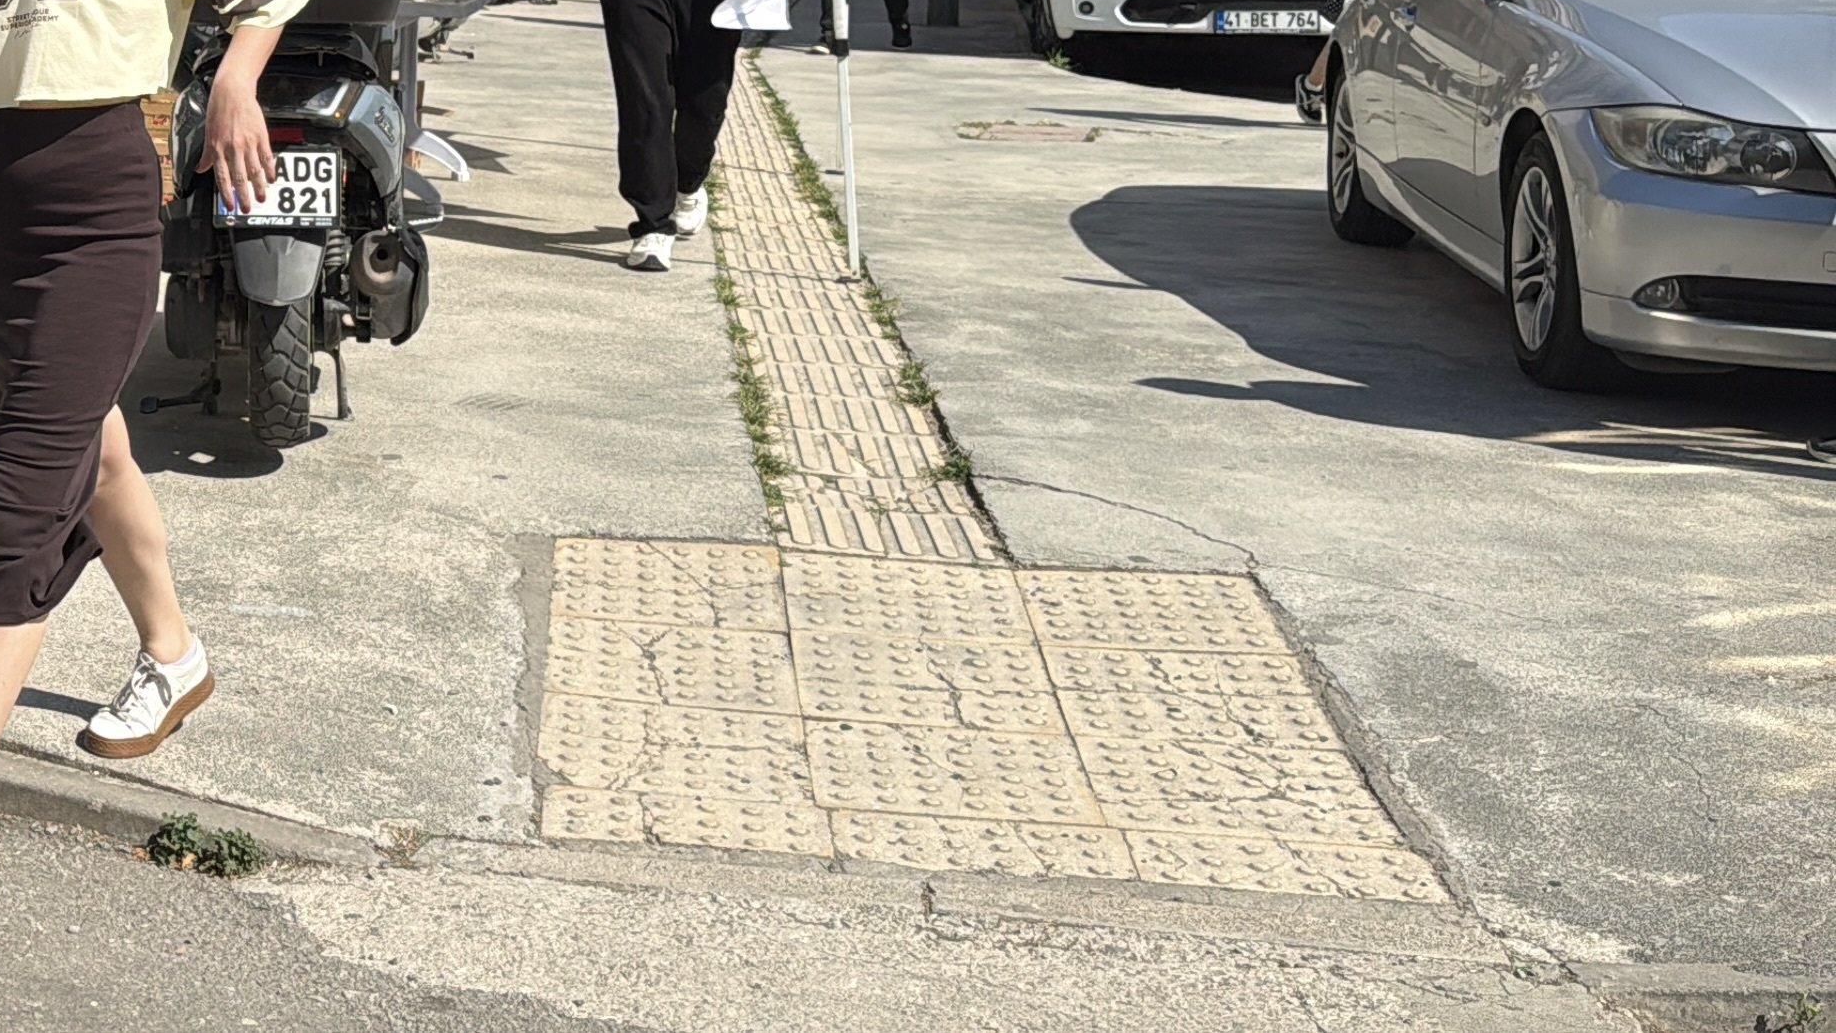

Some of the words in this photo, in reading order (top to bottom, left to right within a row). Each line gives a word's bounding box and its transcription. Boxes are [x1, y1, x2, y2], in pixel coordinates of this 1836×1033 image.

[1225, 12, 1240, 27] 41
[1250, 12, 1279, 27] BET
[1286, 12, 1316, 27] 764
[275, 156, 333, 182] ADG
[277, 186, 332, 214] 821
